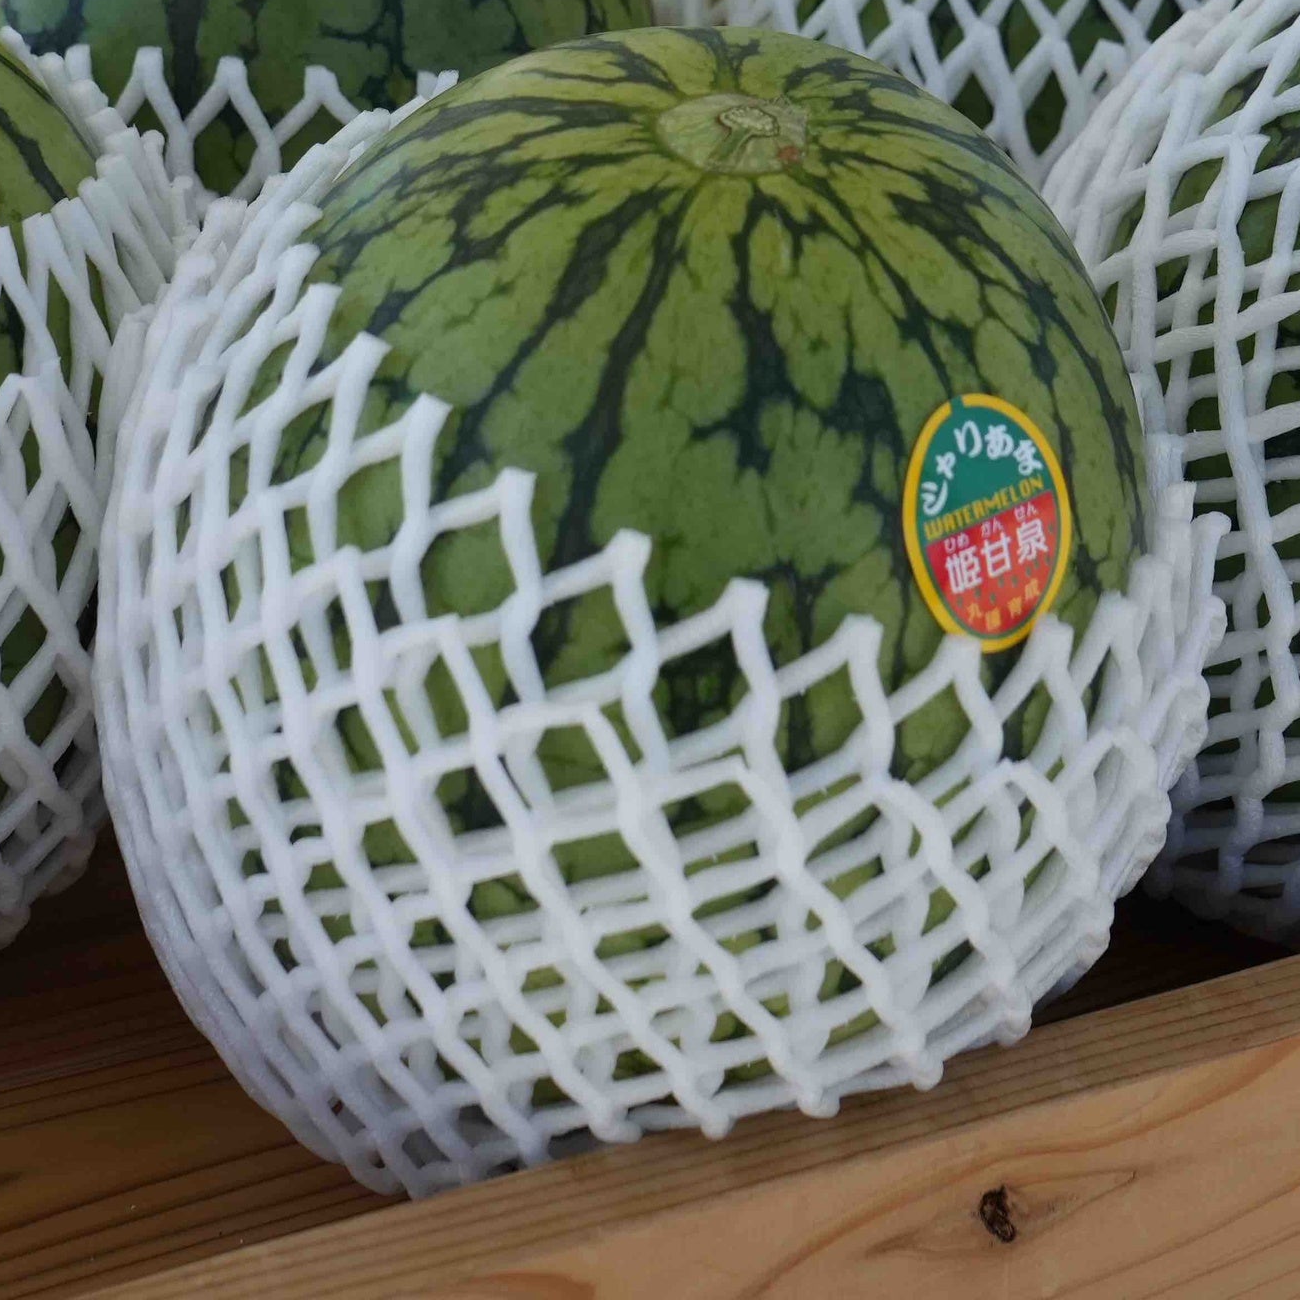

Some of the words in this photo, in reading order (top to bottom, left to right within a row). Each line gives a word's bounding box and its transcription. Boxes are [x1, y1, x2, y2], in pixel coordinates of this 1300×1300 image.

[923, 473, 1045, 541] WATERMELON
[943, 532, 971, 553] ひめ
[1013, 502, 1039, 522] せん
[945, 520, 1050, 595] 姫甘泉
